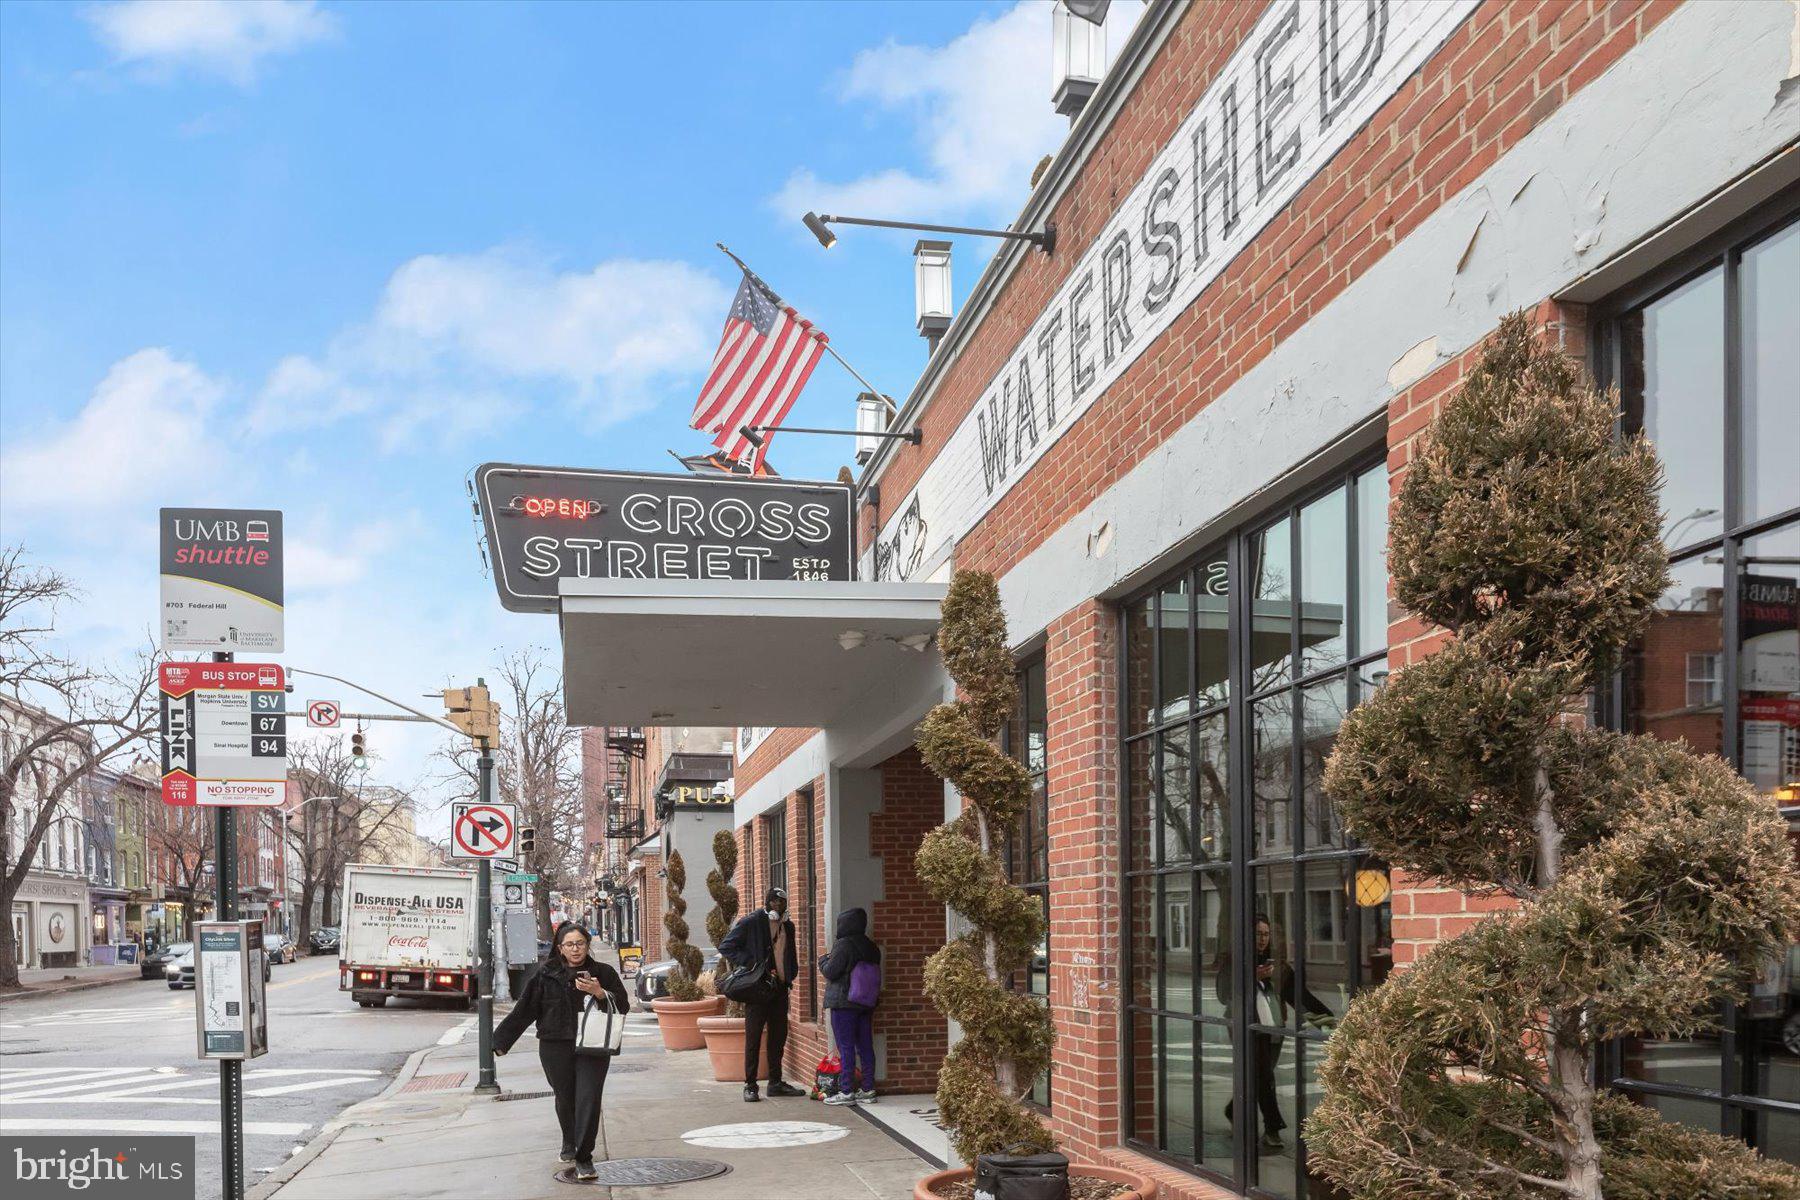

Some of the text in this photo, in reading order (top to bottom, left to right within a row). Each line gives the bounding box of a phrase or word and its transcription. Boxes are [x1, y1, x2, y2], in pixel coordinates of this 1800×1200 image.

[977, 0, 1390, 498] WATERSHED
[526, 498, 586, 516] OPEN
[621, 493, 831, 542] CROSS
[174, 519, 240, 542] UMB
[174, 544, 270, 566] shuttle
[522, 536, 771, 581] STREET
[792, 557, 831, 569] ESTD
[792, 570, 829, 581] 1846
[202, 671, 256, 681] BUS STOP
[258, 695, 279, 709] SV
[259, 717, 278, 731] 67
[170, 709, 186, 760] LINK
[260, 740, 278, 754] 94
[225, 786, 275, 794] STOPPING
[42, 884, 67, 896] SHOES
[436, 895, 464, 910] USA
